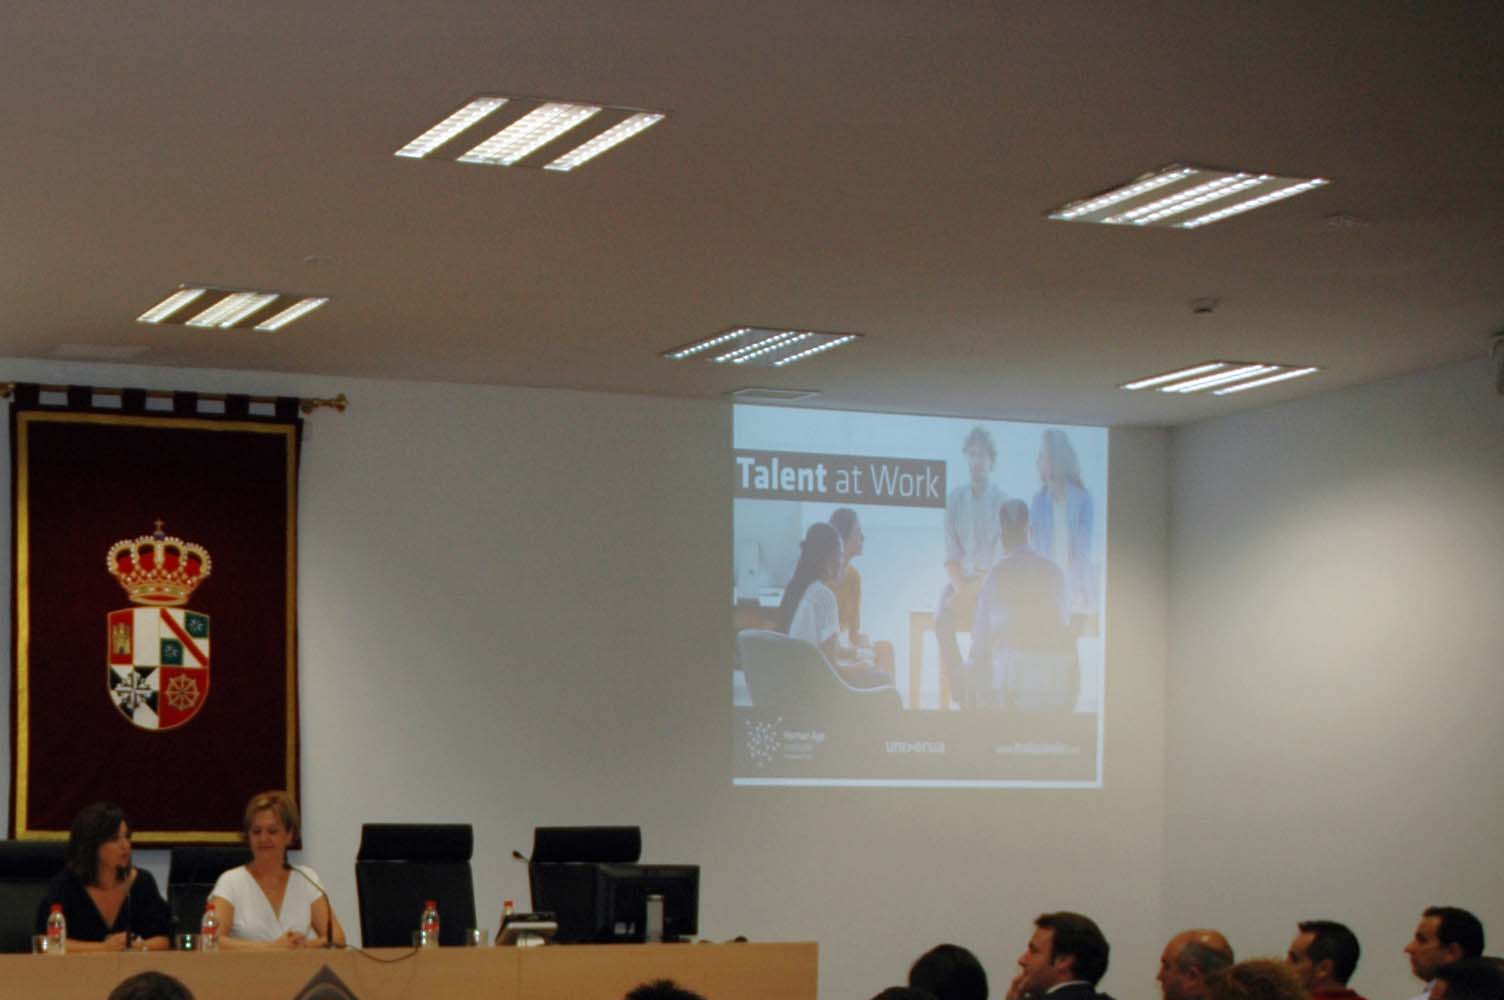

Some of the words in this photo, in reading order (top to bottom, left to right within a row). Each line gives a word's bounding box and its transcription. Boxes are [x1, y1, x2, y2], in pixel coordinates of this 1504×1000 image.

[736, 456, 828, 494] Talent
[835, 468, 863, 495] at
[870, 464, 940, 498] Work
